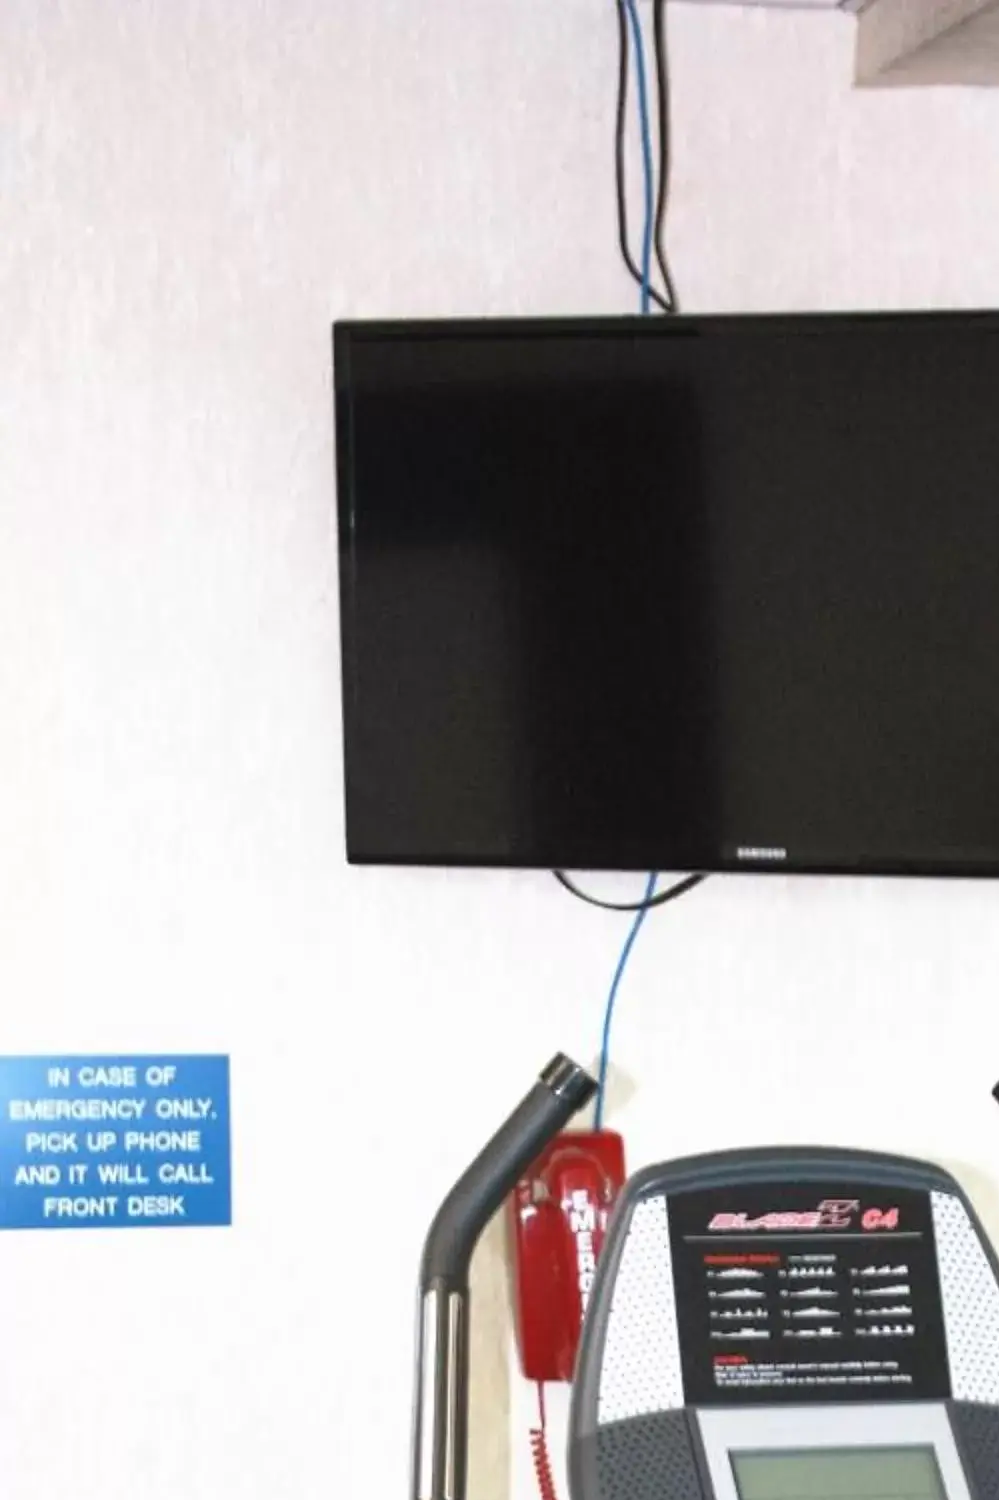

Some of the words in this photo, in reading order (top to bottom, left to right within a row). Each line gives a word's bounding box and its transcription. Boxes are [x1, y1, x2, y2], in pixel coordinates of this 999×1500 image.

[47, 1066, 69, 1088] IN
[78, 1065, 137, 1088] CASE
[145, 1065, 177, 1087] OF
[8, 1098, 146, 1121] EMERGENCY
[155, 1098, 218, 1120] ONLY.
[26, 1131, 78, 1153] PICK
[87, 1131, 117, 1152] UP
[124, 1130, 202, 1152] PHONE
[14, 1164, 60, 1186] AND
[68, 1164, 88, 1185] IT
[97, 1163, 149, 1185] WILL
[158, 1162, 215, 1184] CALL
[43, 1197, 118, 1219] FRONT
[127, 1195, 186, 1217] DESK
